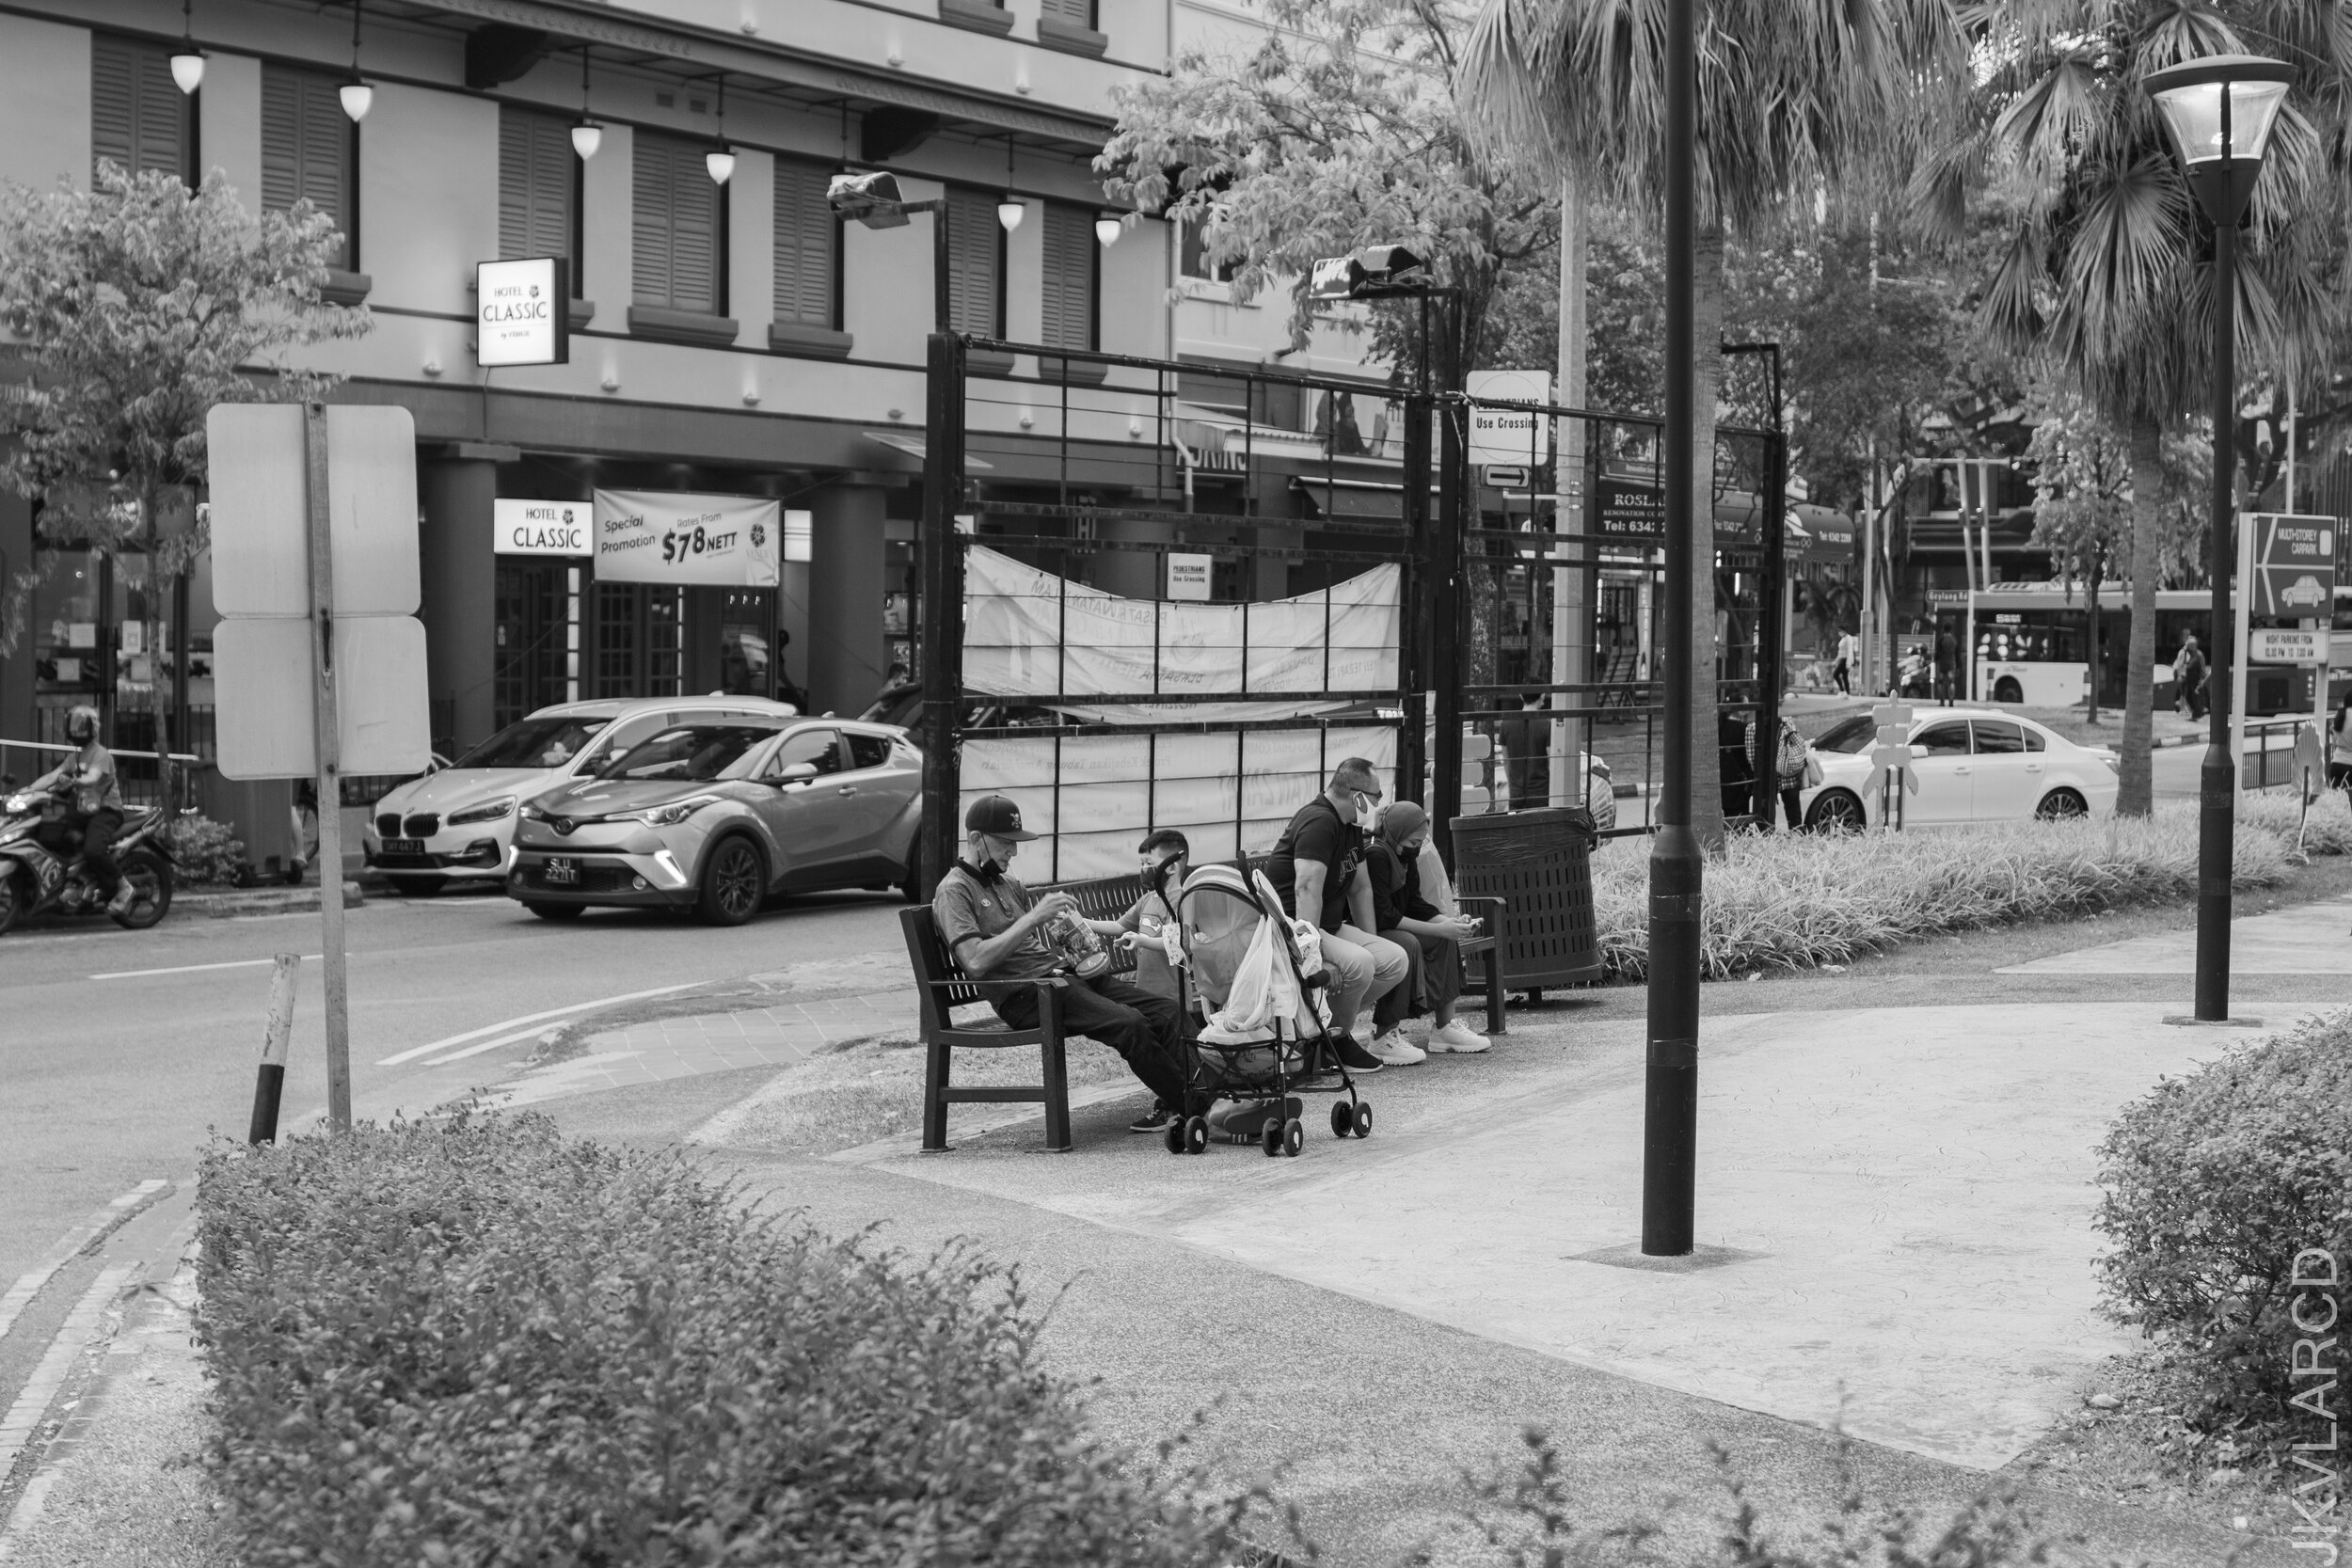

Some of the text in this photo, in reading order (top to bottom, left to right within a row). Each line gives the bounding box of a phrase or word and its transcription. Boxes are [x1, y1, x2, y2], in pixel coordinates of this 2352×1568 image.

[494, 285, 522, 298] HOTEL
[483, 301, 548, 322] CLASSIC
[1476, 417, 1539, 431] Use Crossing
[526, 508, 558, 520] HOTEL
[604, 515, 644, 535] Special
[677, 513, 723, 529] Rates From
[1603, 520, 1626, 531] Tel:
[513, 527, 581, 548] CLASSIC
[2278, 528, 2317, 541] MULTI-STOREY
[601, 533, 656, 554] Promotion
[662, 525, 738, 565] $78 NETT
[2291, 542, 2317, 555] CARPARK
[1929, 592, 1957, 601] Geylang
[2280, 634, 2299, 644] PARKING
[2301, 634, 2313, 644] FROM
[550, 858, 570, 869] SLU
